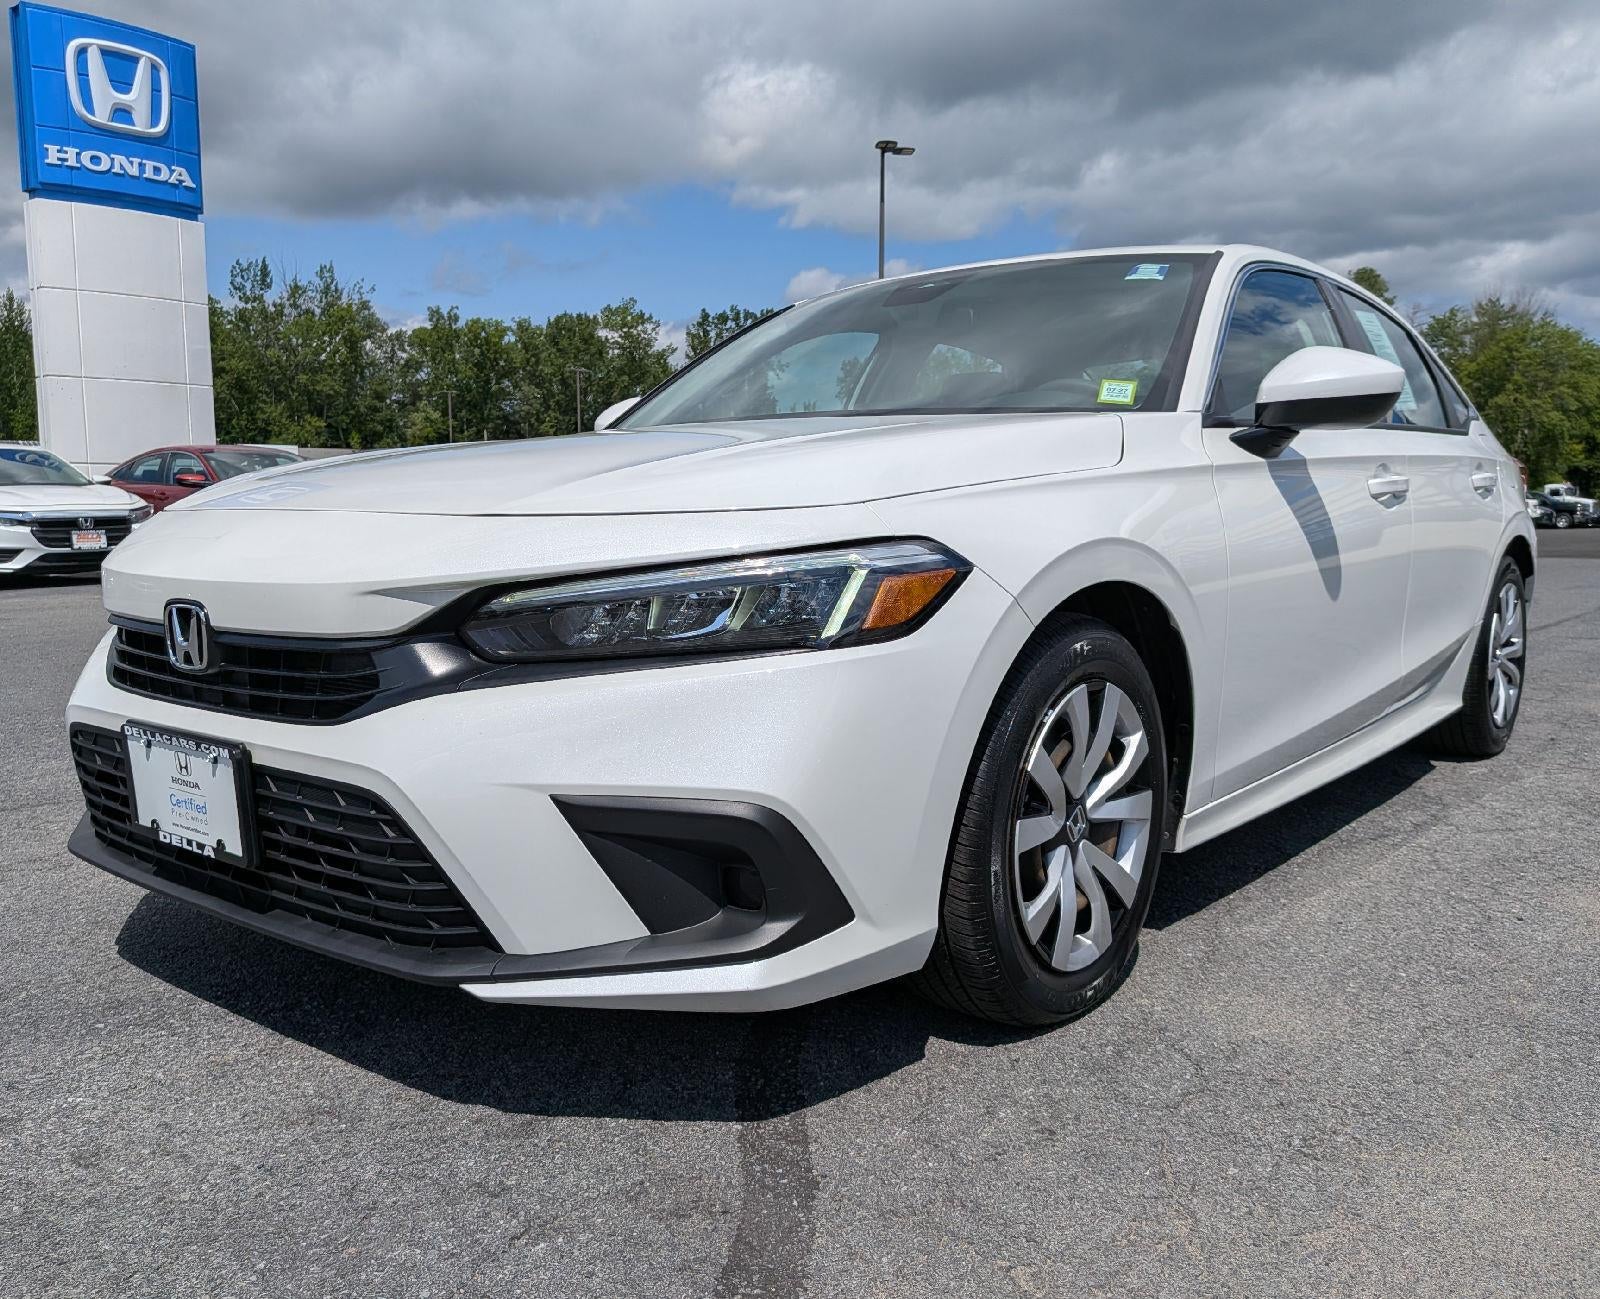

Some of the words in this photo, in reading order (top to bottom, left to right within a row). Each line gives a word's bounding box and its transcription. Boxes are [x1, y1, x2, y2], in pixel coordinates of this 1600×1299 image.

[43, 144, 197, 189] HONDA
[123, 725, 230, 759] DELLACARS.COM
[171, 776, 202, 791] HONDA
[169, 793, 208, 815] Certified
[159, 831, 216, 859] DELLA
